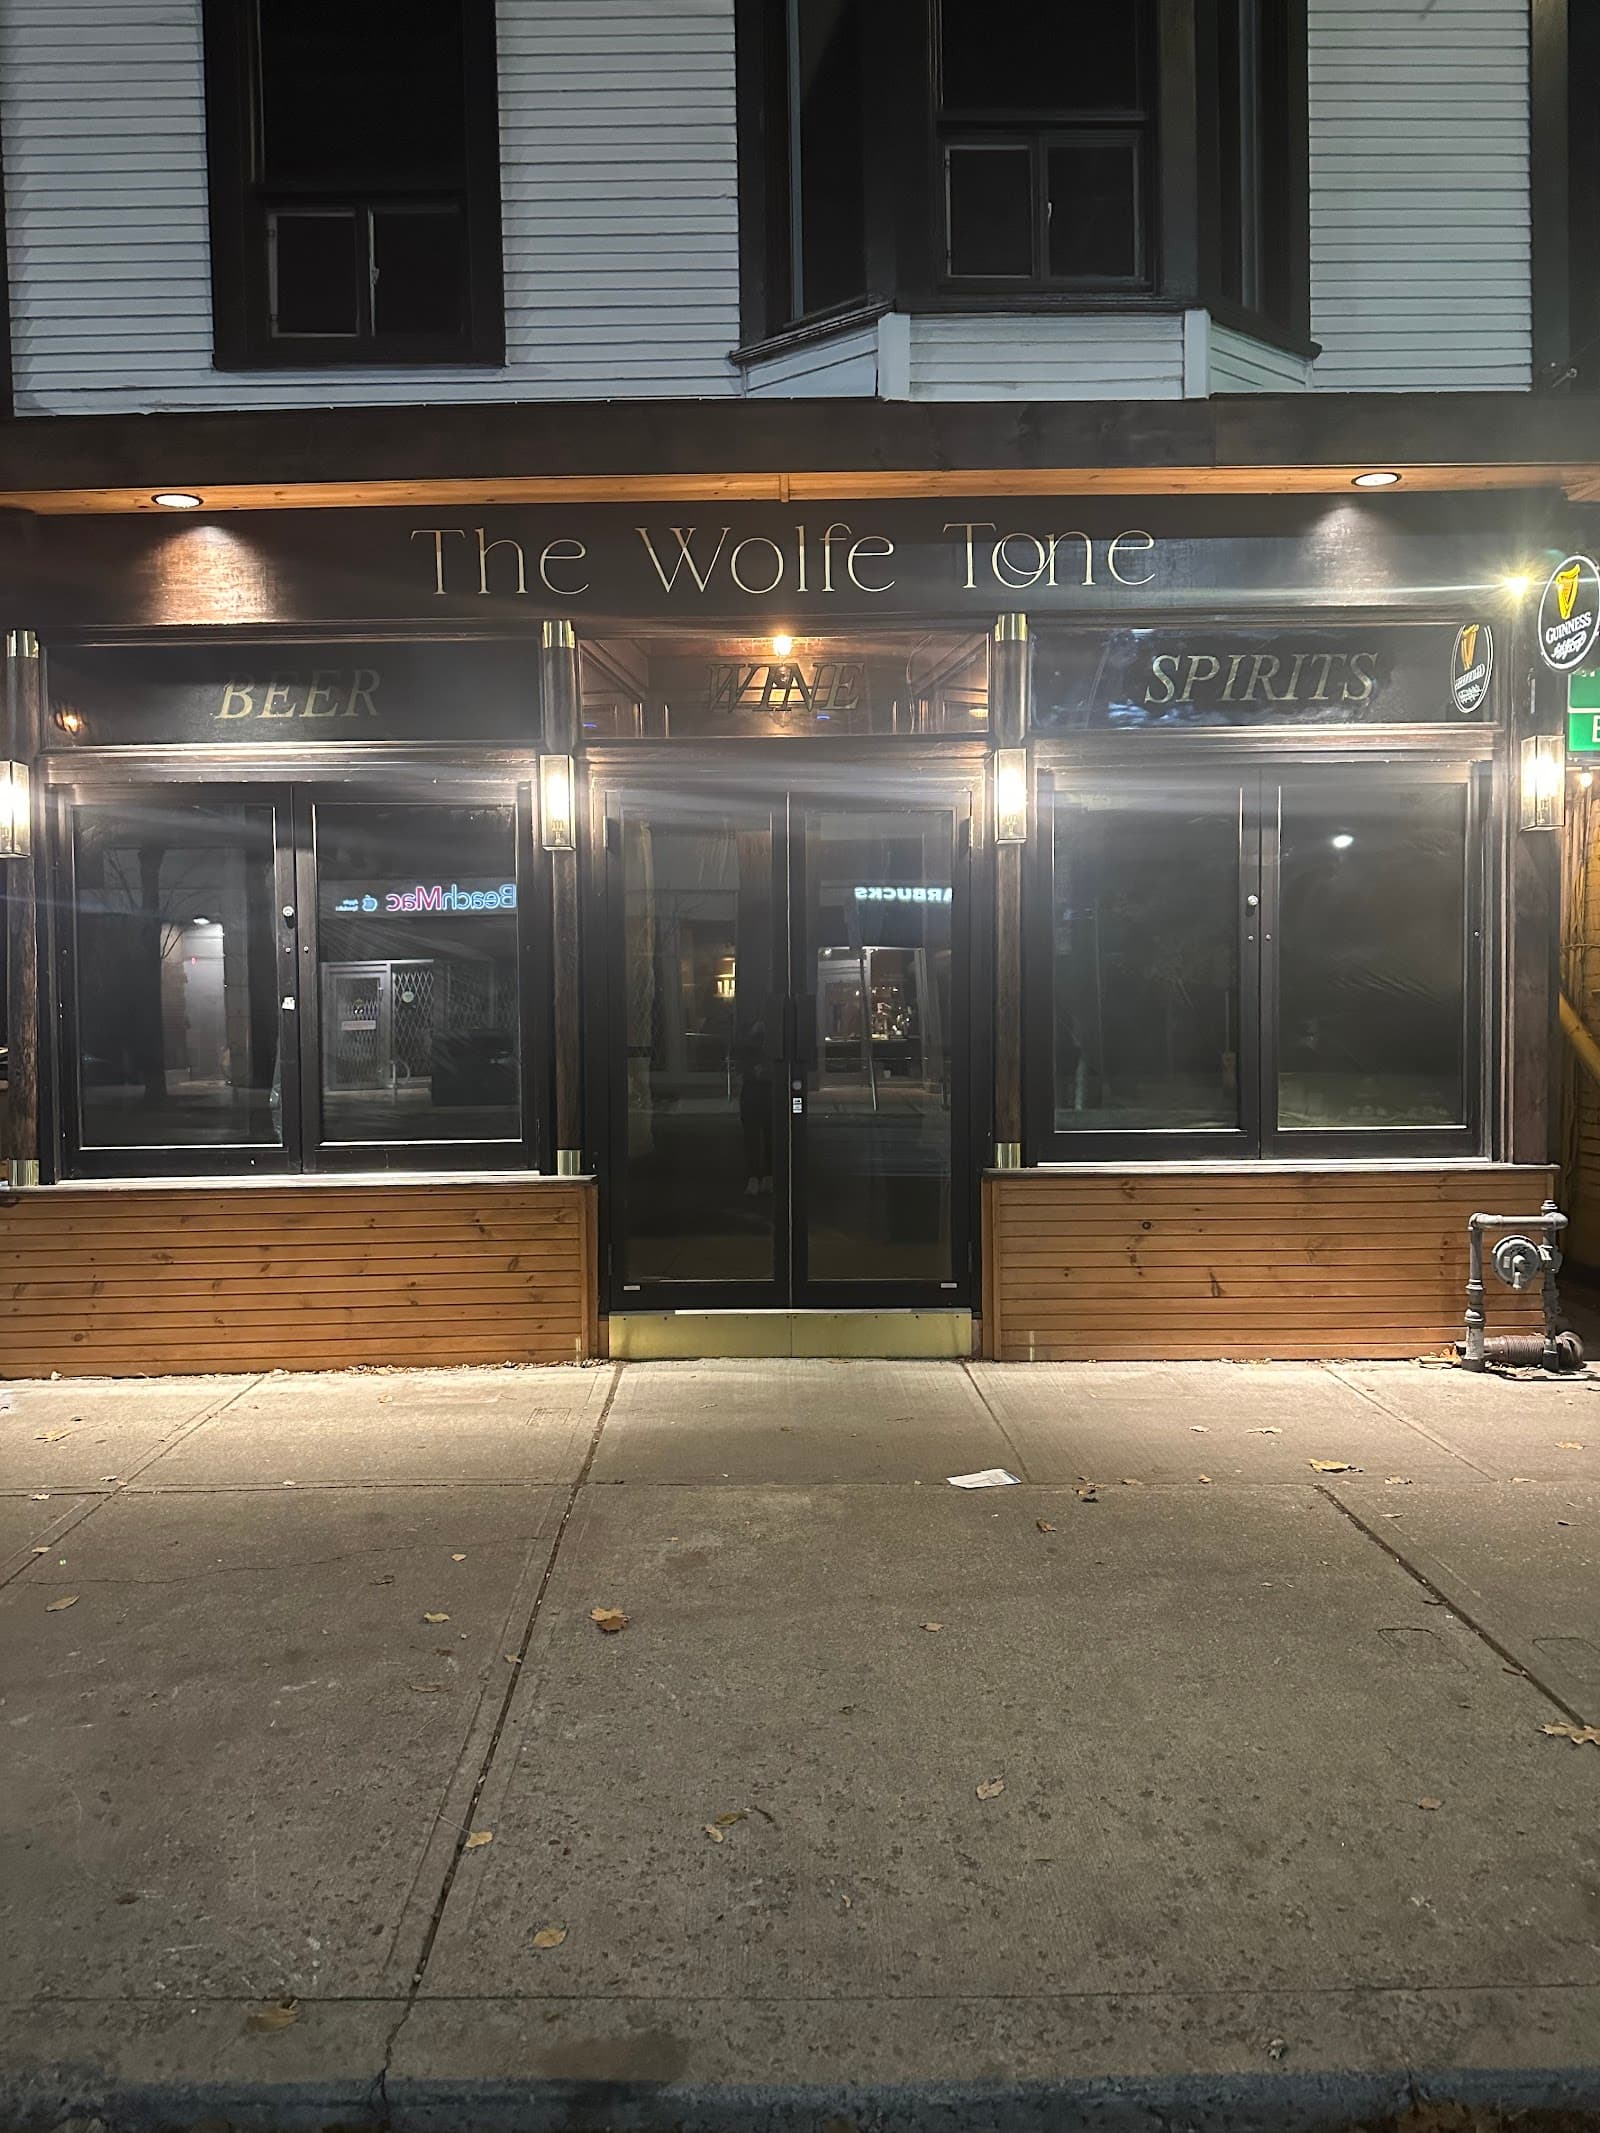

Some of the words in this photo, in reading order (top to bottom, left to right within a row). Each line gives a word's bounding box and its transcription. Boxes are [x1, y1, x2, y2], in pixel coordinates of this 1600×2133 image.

[410, 527, 590, 596] The
[634, 522, 896, 595] Wolfe
[942, 522, 1156, 590] Tone
[1545, 611, 1592, 645] GUINNESS
[213, 669, 382, 720] BEER
[705, 661, 865, 714] WINE
[1143, 651, 1380, 705] SPIRITS
